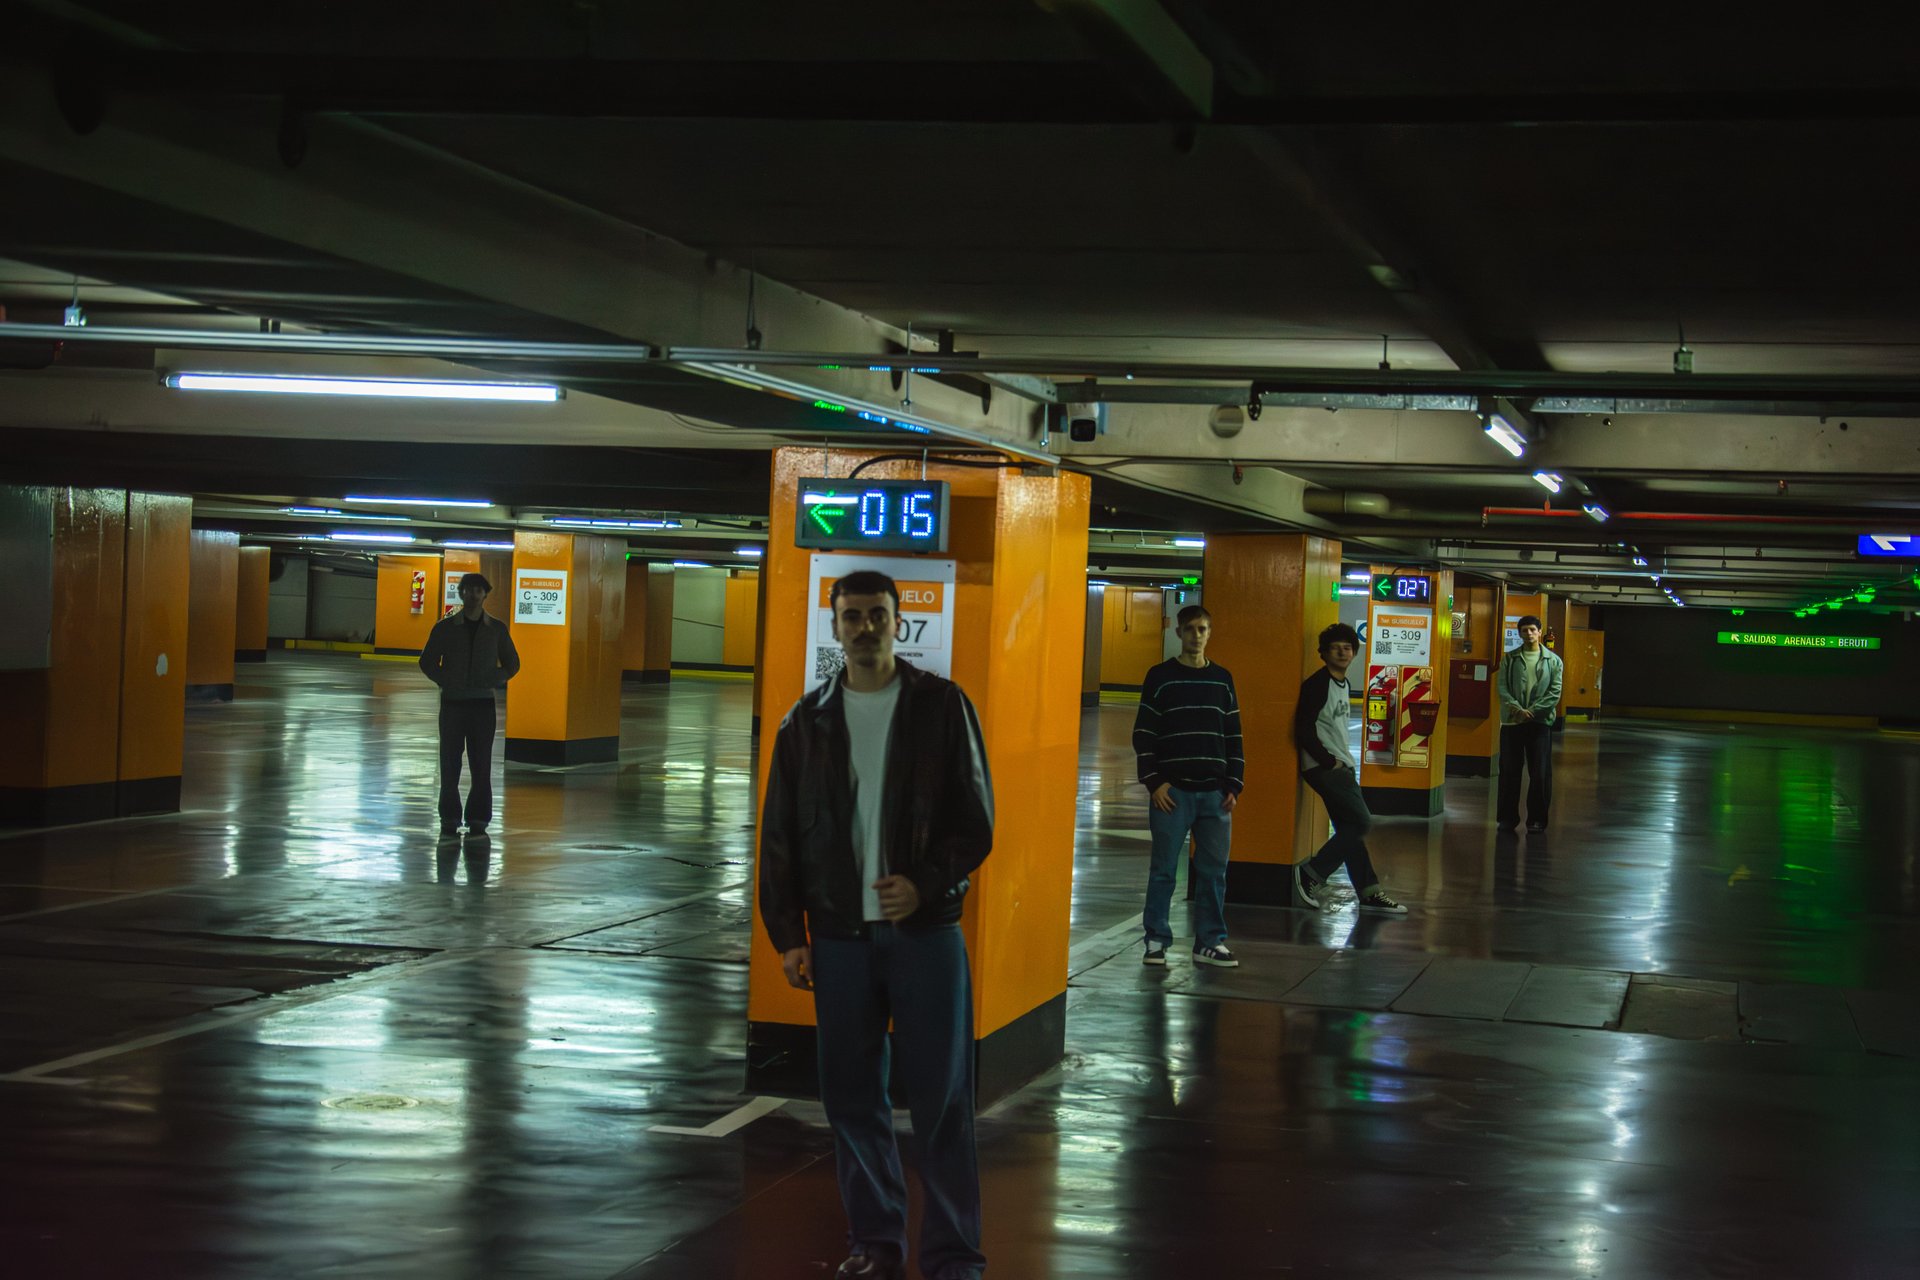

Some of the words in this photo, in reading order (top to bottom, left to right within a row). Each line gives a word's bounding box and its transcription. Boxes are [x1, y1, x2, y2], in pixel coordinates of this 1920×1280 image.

[861, 492, 932, 537] 015
[523, 591, 531, 600] C
[540, 591, 558, 601] 309
[1397, 579, 1428, 597] 027
[896, 619, 928, 644] 07
[1382, 629, 1390, 639] B
[1400, 630, 1421, 641] 309
[1743, 634, 1777, 645] SALIDAS
[1784, 636, 1826, 647] ARENALES
[1838, 638, 1868, 648] BERUTI
